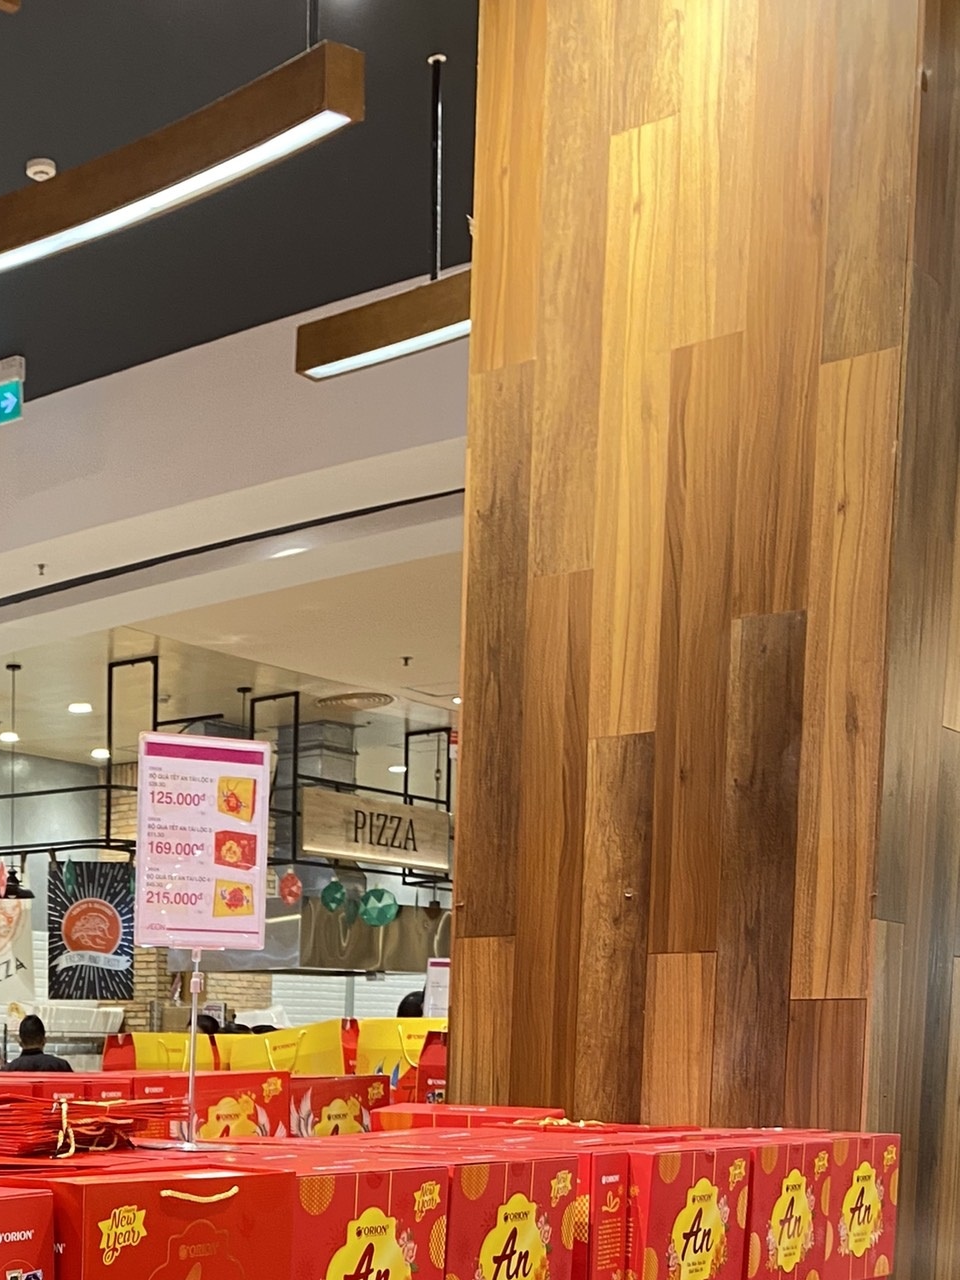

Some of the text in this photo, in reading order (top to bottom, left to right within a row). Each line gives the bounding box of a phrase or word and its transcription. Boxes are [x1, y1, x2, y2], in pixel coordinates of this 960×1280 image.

[354, 810, 418, 851] PIZZA
[109, 1210, 136, 1231] New
[778, 1196, 802, 1246] An
[849, 1187, 873, 1231] An
[2, 1230, 32, 1242] ORION
[104, 1227, 140, 1264] Year
[364, 1225, 387, 1237] ORION
[681, 1207, 714, 1261] An
